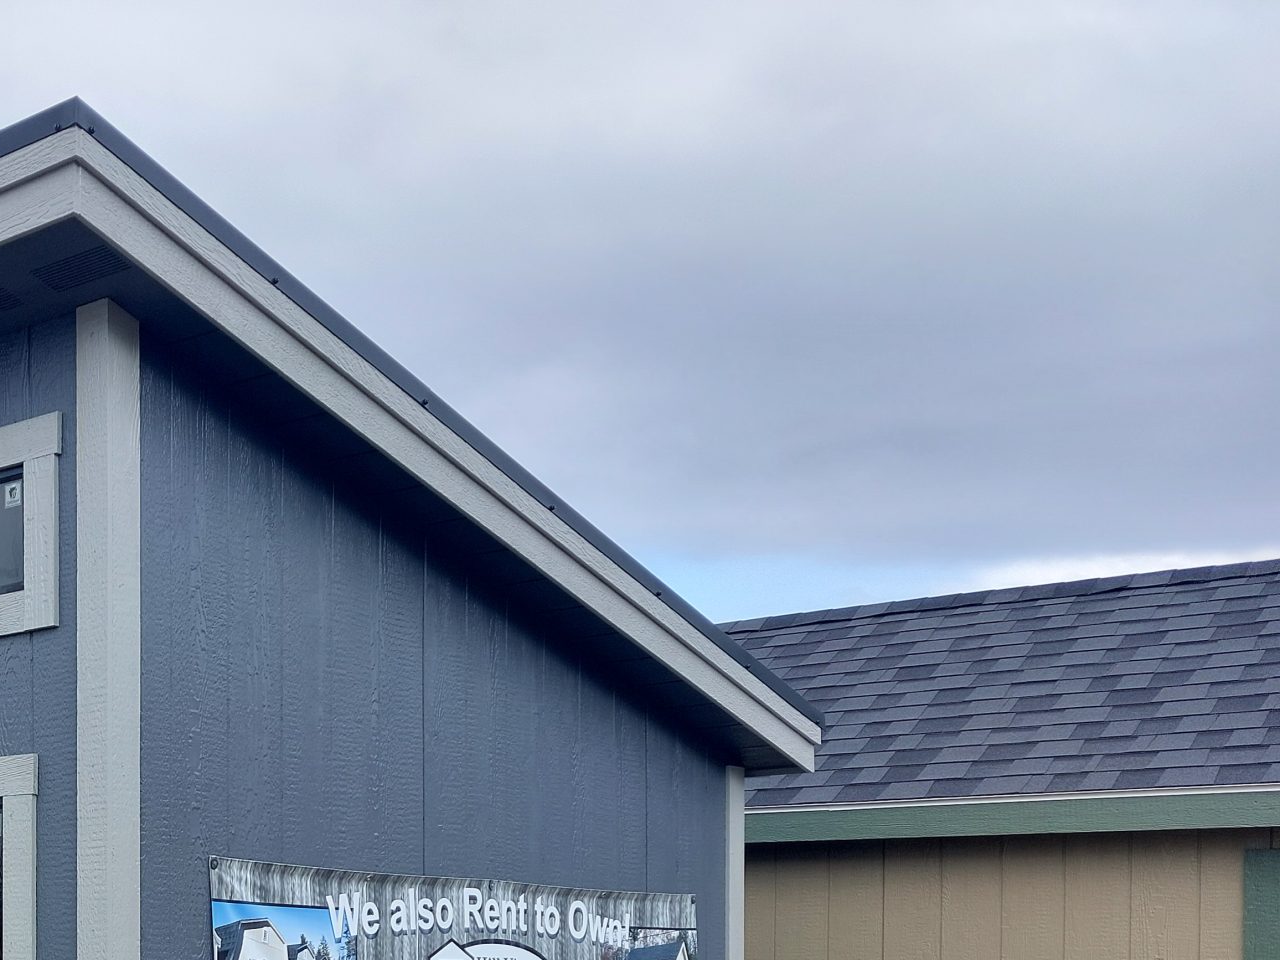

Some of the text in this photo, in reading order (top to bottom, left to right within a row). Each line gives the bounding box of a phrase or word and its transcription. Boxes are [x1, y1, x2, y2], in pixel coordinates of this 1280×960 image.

[326, 887, 631, 950] We also Rent to Own!
